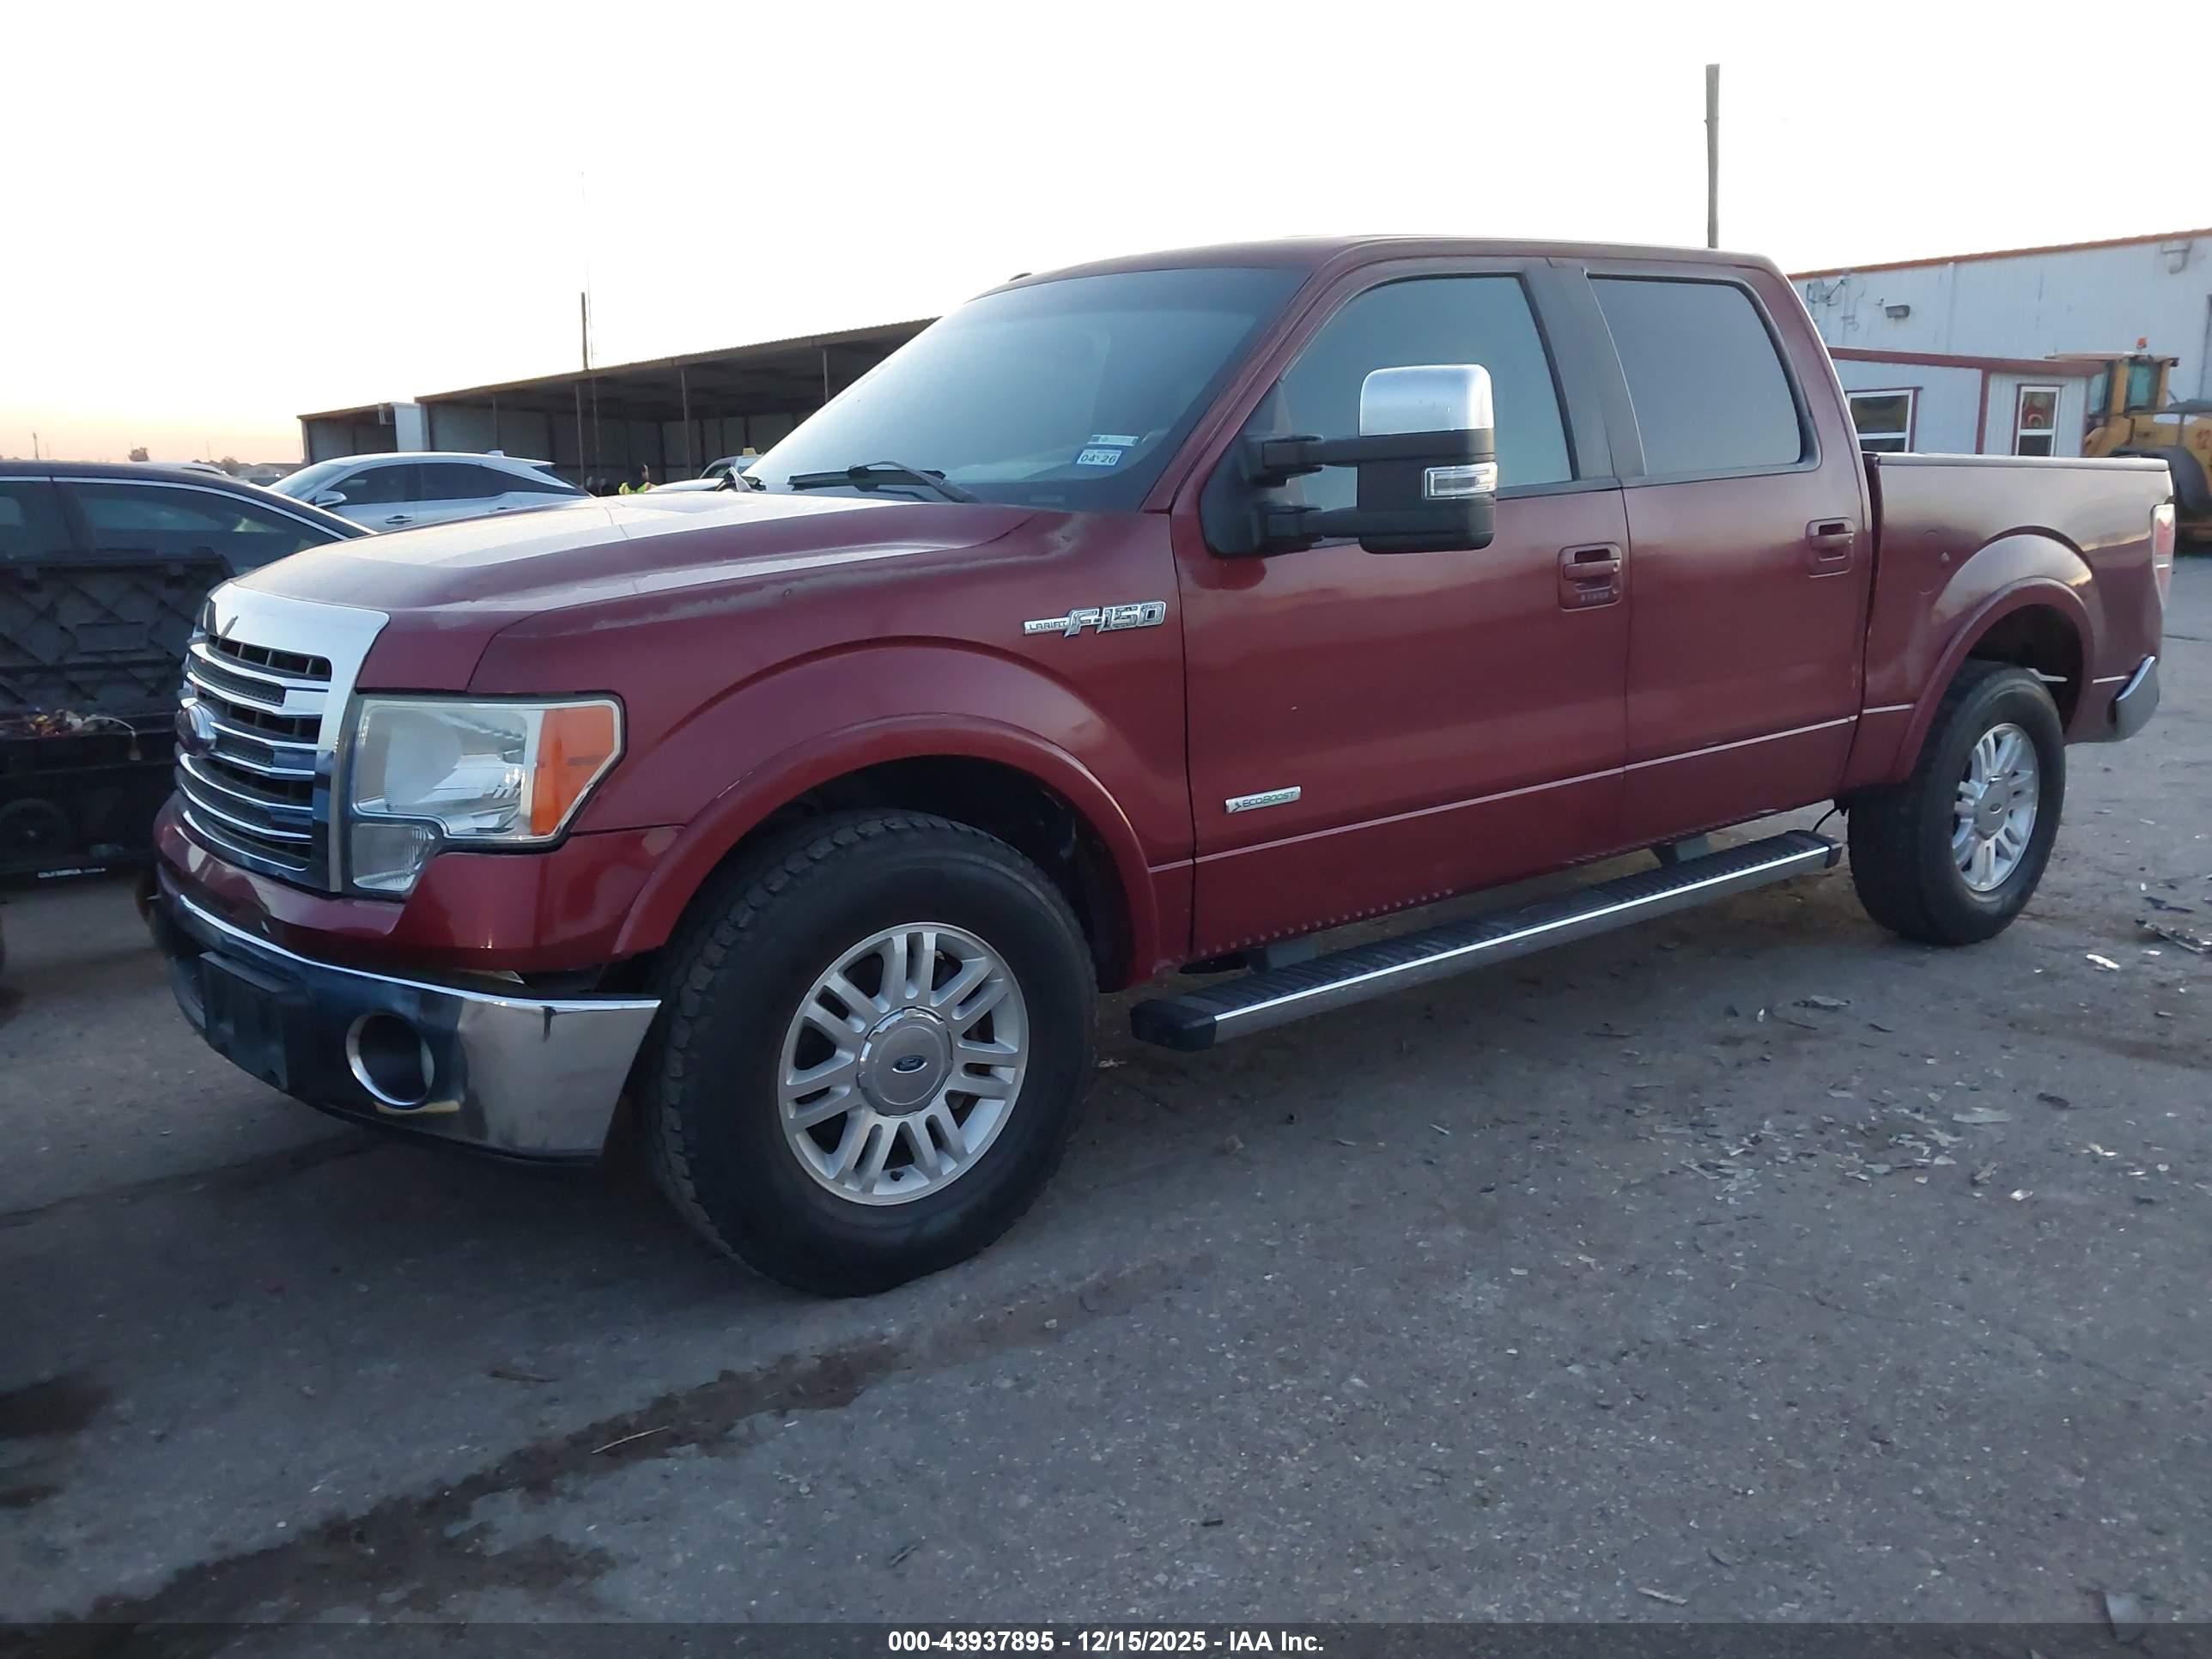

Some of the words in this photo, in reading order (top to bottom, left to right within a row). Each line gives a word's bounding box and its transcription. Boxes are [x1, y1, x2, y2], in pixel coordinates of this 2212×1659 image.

[1030, 620, 1067, 631] LARIAT
[1064, 601, 1167, 638] F-150
[1243, 791, 1297, 808] ECOBOOST
